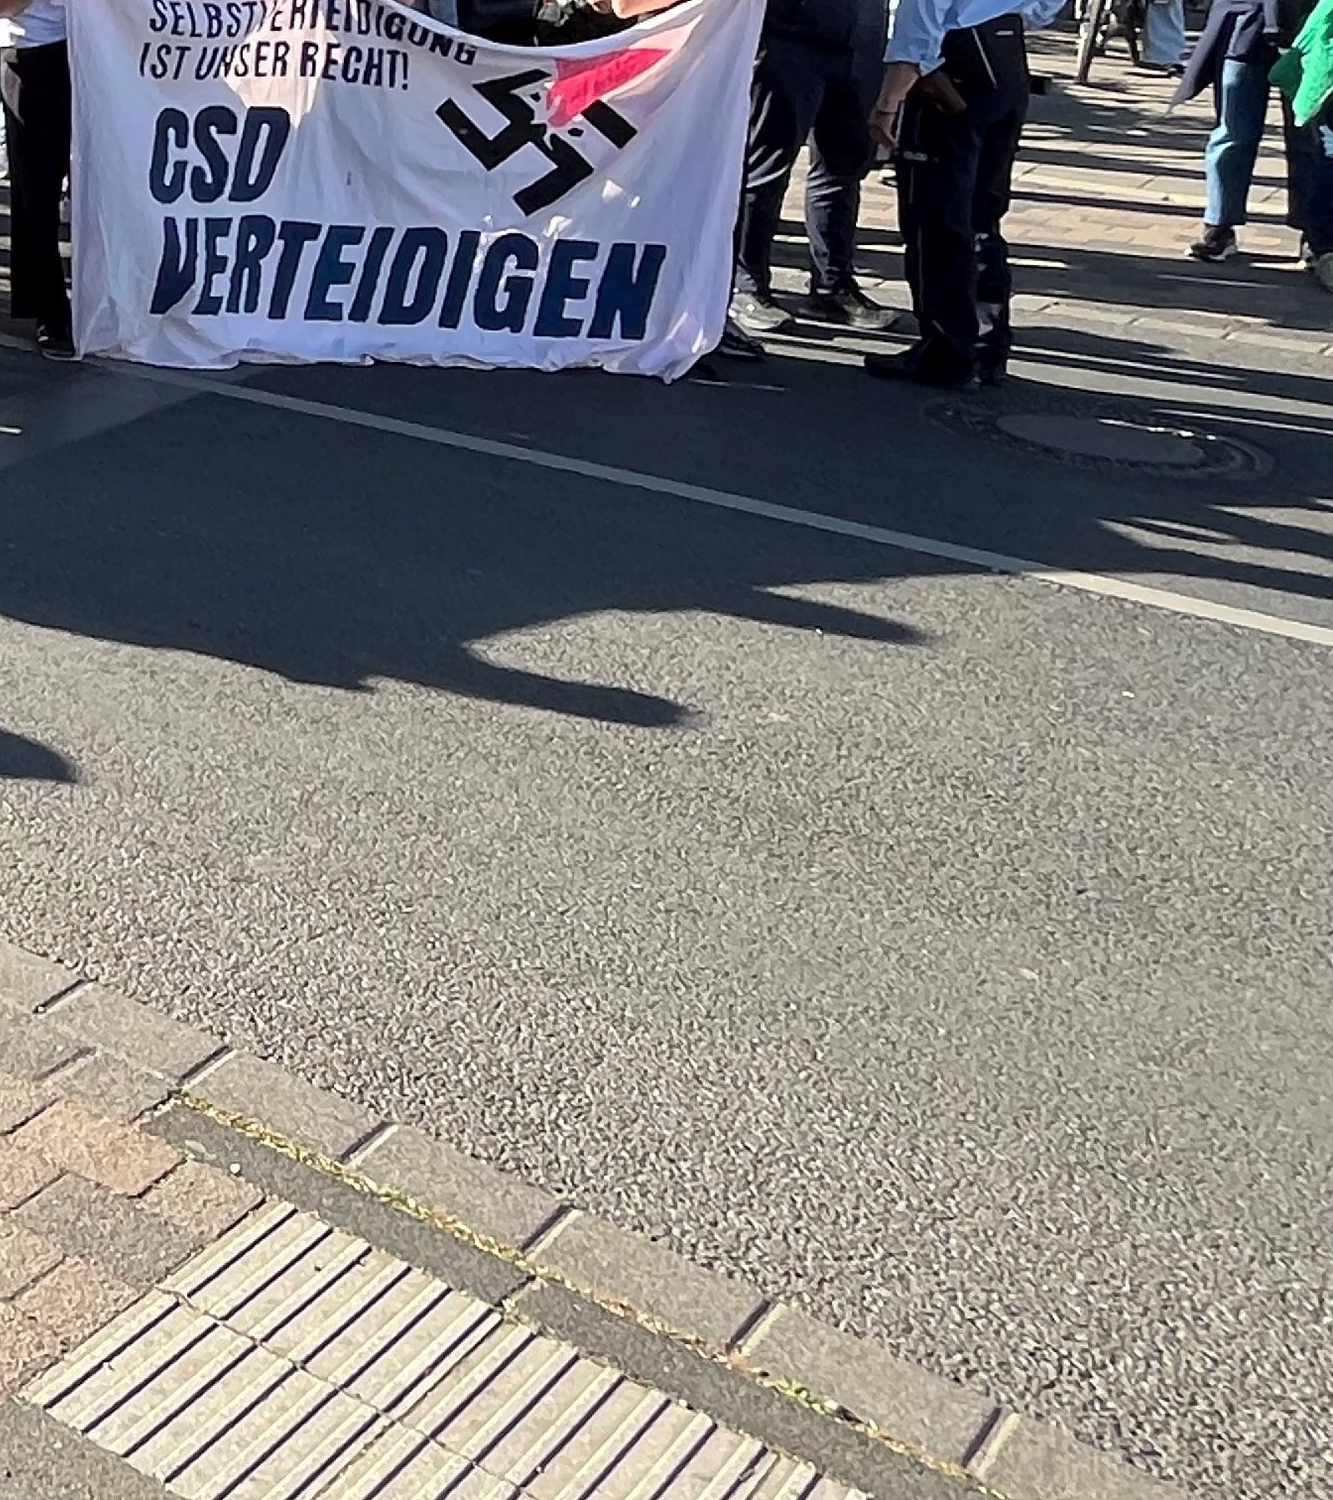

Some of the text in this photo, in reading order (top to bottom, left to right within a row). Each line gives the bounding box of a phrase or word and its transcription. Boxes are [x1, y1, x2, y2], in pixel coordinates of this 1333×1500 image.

[139, 40, 410, 91] IST UNSER RECHT!
[148, 104, 291, 204] CSD
[148, 215, 669, 341] VERTEIDIGEN
